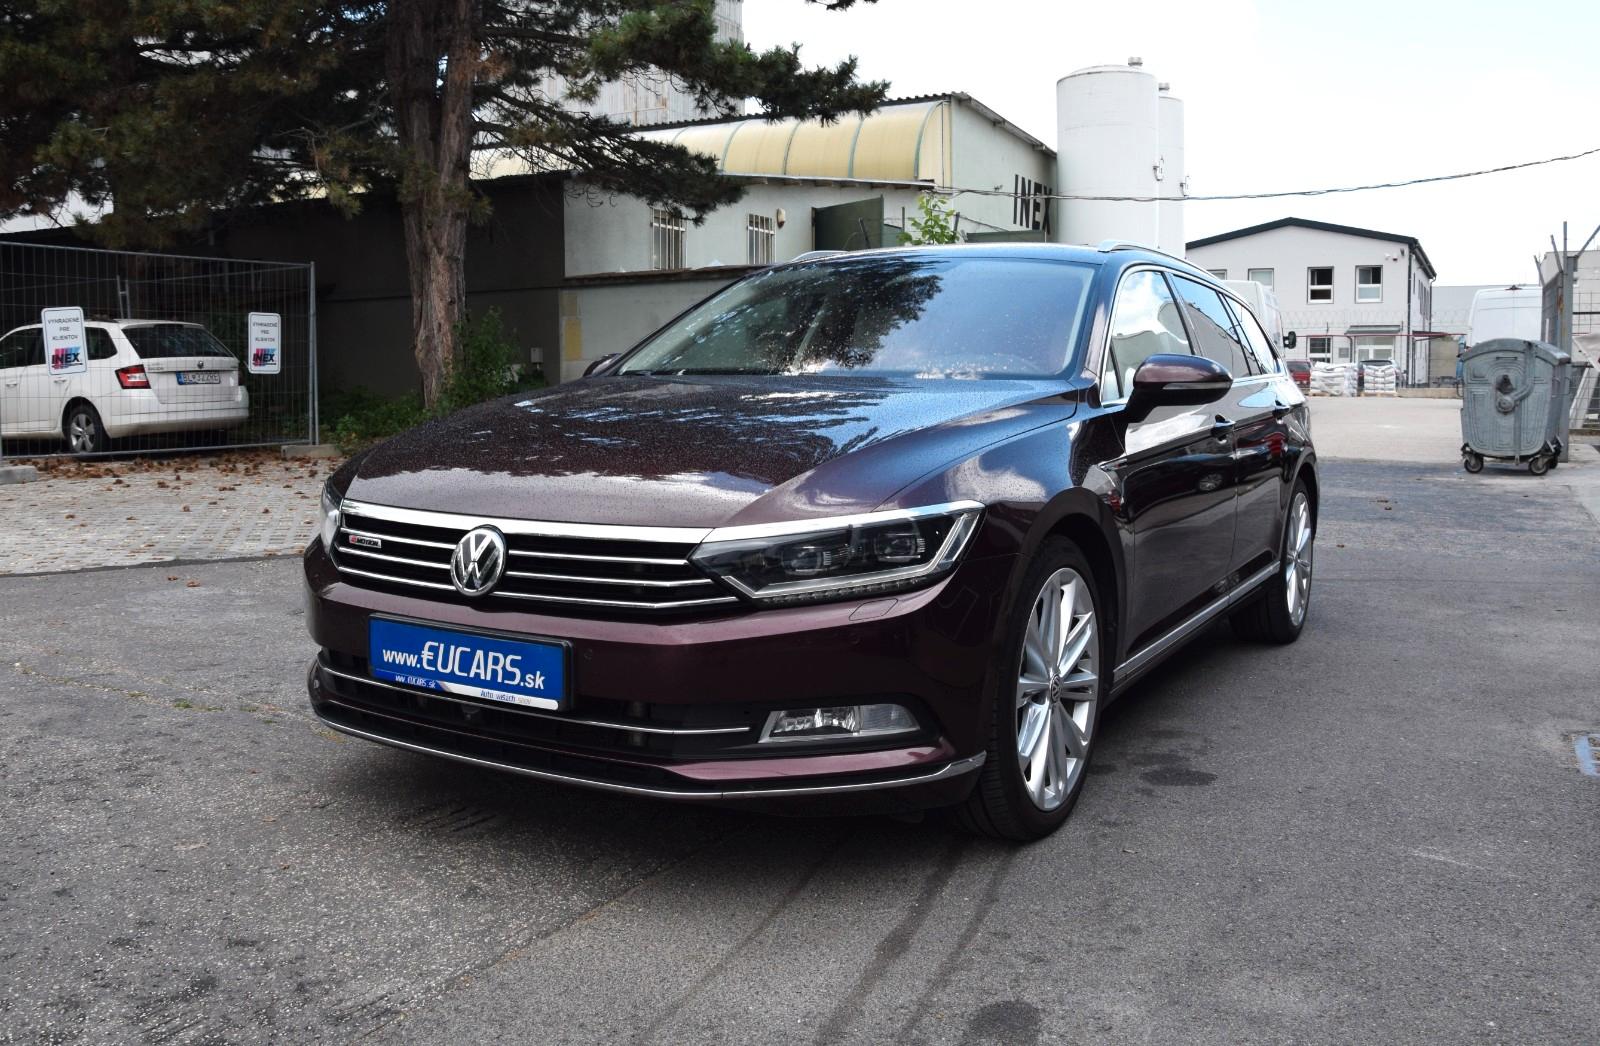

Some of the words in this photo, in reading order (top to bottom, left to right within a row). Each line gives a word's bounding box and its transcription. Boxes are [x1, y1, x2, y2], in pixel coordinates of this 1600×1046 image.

[1013, 174, 1052, 235] INEX
[51, 352, 81, 364] INEX
[253, 353, 275, 363] INEX
[480, 690, 494, 699] Auto
